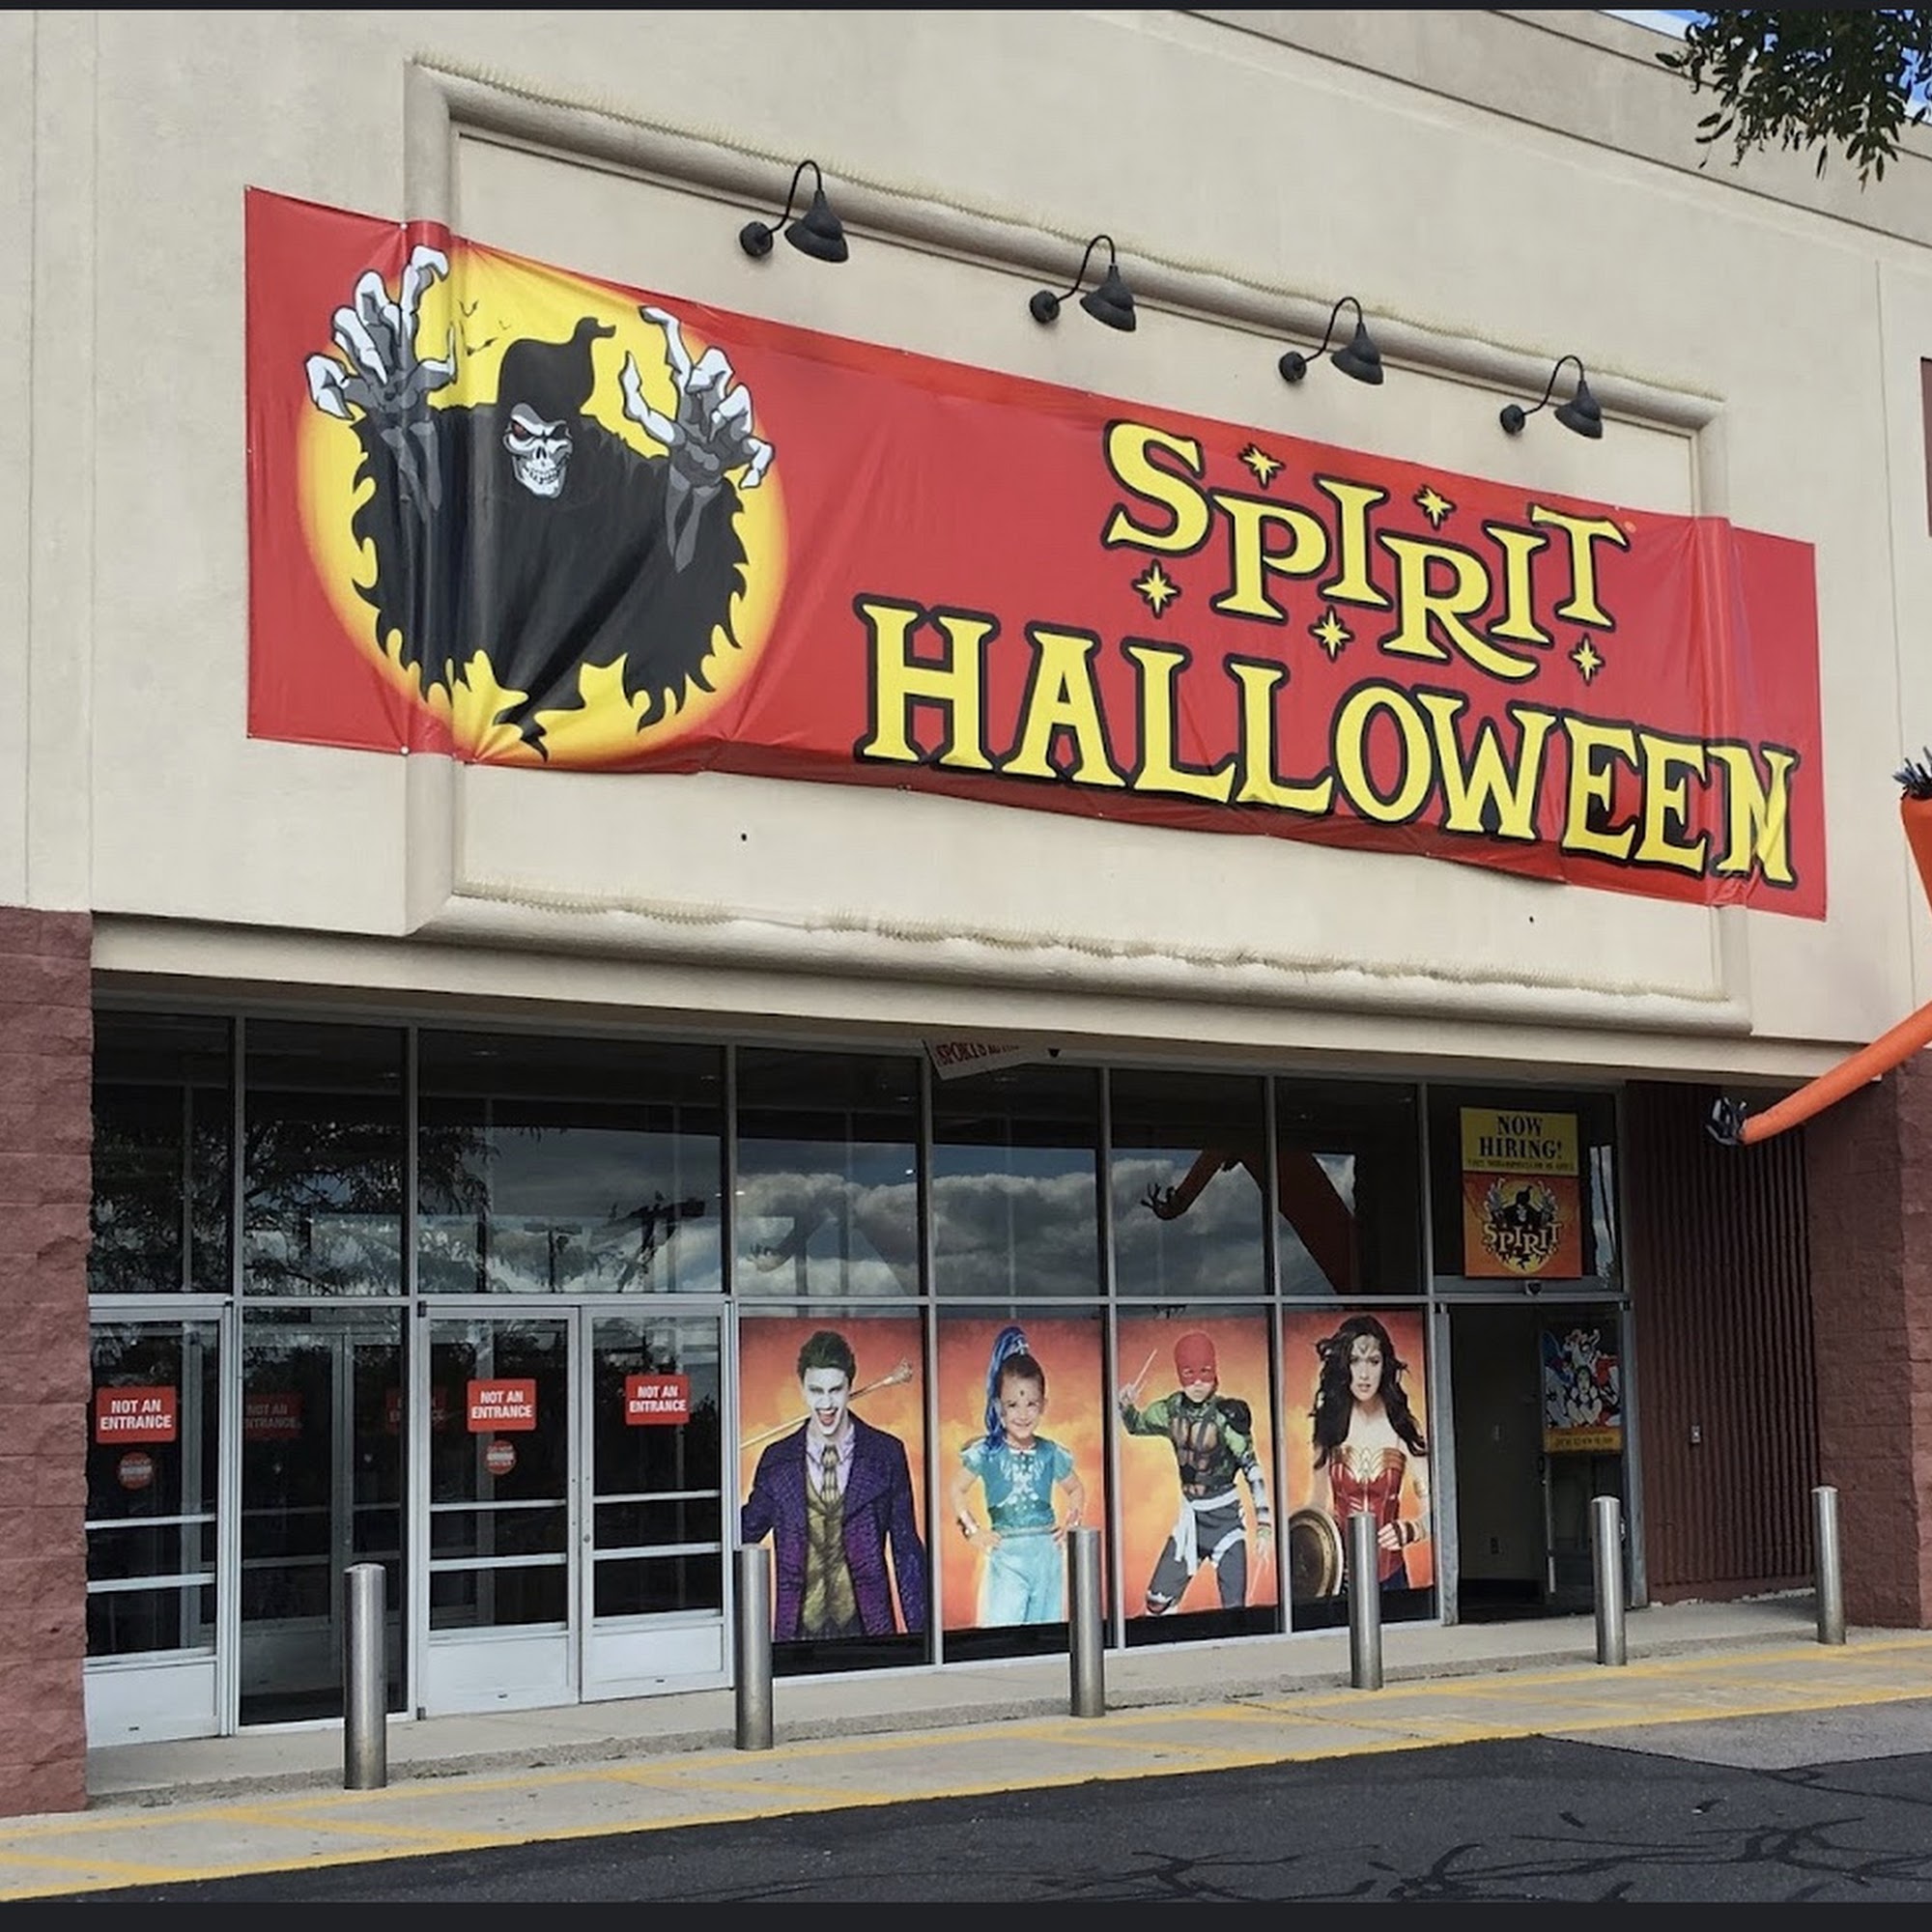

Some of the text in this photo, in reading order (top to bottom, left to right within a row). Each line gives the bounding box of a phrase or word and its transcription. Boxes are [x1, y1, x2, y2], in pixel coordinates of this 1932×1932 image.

[1101, 417, 1630, 682] SPIRIT
[852, 592, 1802, 888] HALLOWEEN
[1497, 1116, 1543, 1136] NOW
[1479, 1136, 1563, 1159] HIRING!
[1483, 1221, 1563, 1256] SPIRIT
[480, 1390, 524, 1403] NOT AN
[638, 1385, 679, 1399] NOT AN
[111, 1399, 161, 1413] NOT AN
[471, 1404, 532, 1419] ENTRANCE
[629, 1400, 687, 1413] ENTRANCE
[99, 1415, 172, 1431] ENTRANCE
